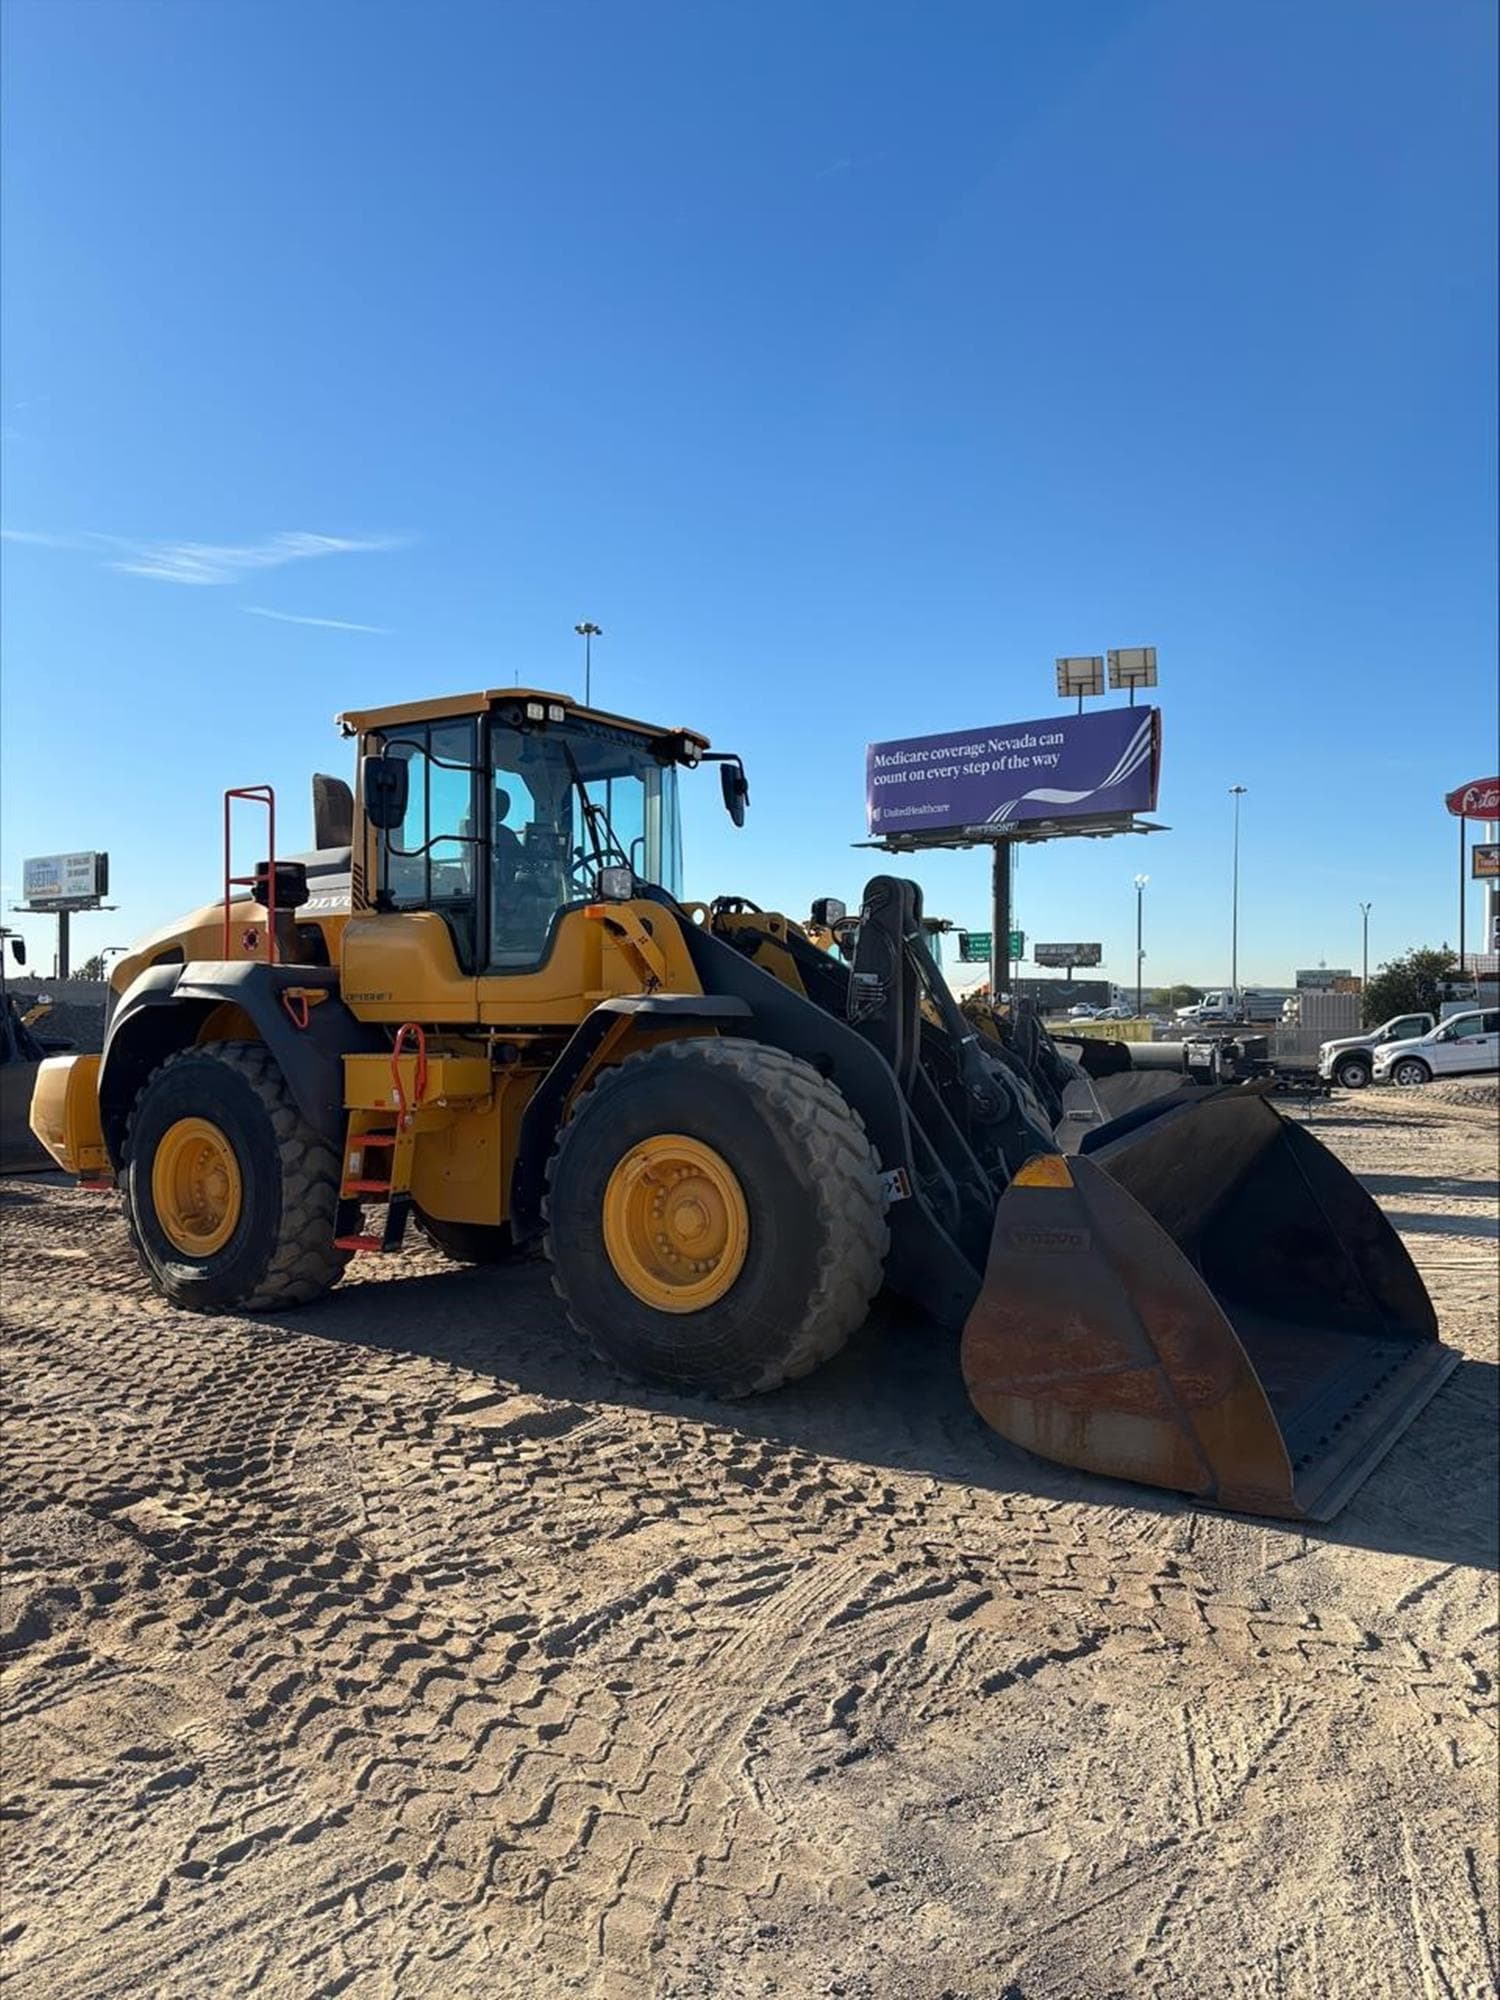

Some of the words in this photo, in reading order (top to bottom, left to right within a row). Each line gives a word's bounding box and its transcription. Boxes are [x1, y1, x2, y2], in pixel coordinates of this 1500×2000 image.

[874, 751, 929, 768] Medicare
[930, 743, 985, 760] coverage
[988, 734, 1037, 752] Nevada
[1039, 733, 1064, 746] can
[874, 771, 907, 785] count
[909, 769, 925, 781] on
[926, 765, 960, 779] every
[962, 761, 990, 775] step
[992, 756, 1007, 770] of
[1008, 754, 1030, 769] the
[1032, 753, 1060, 768] way
[883, 804, 950, 818] UnitedHealthcare
